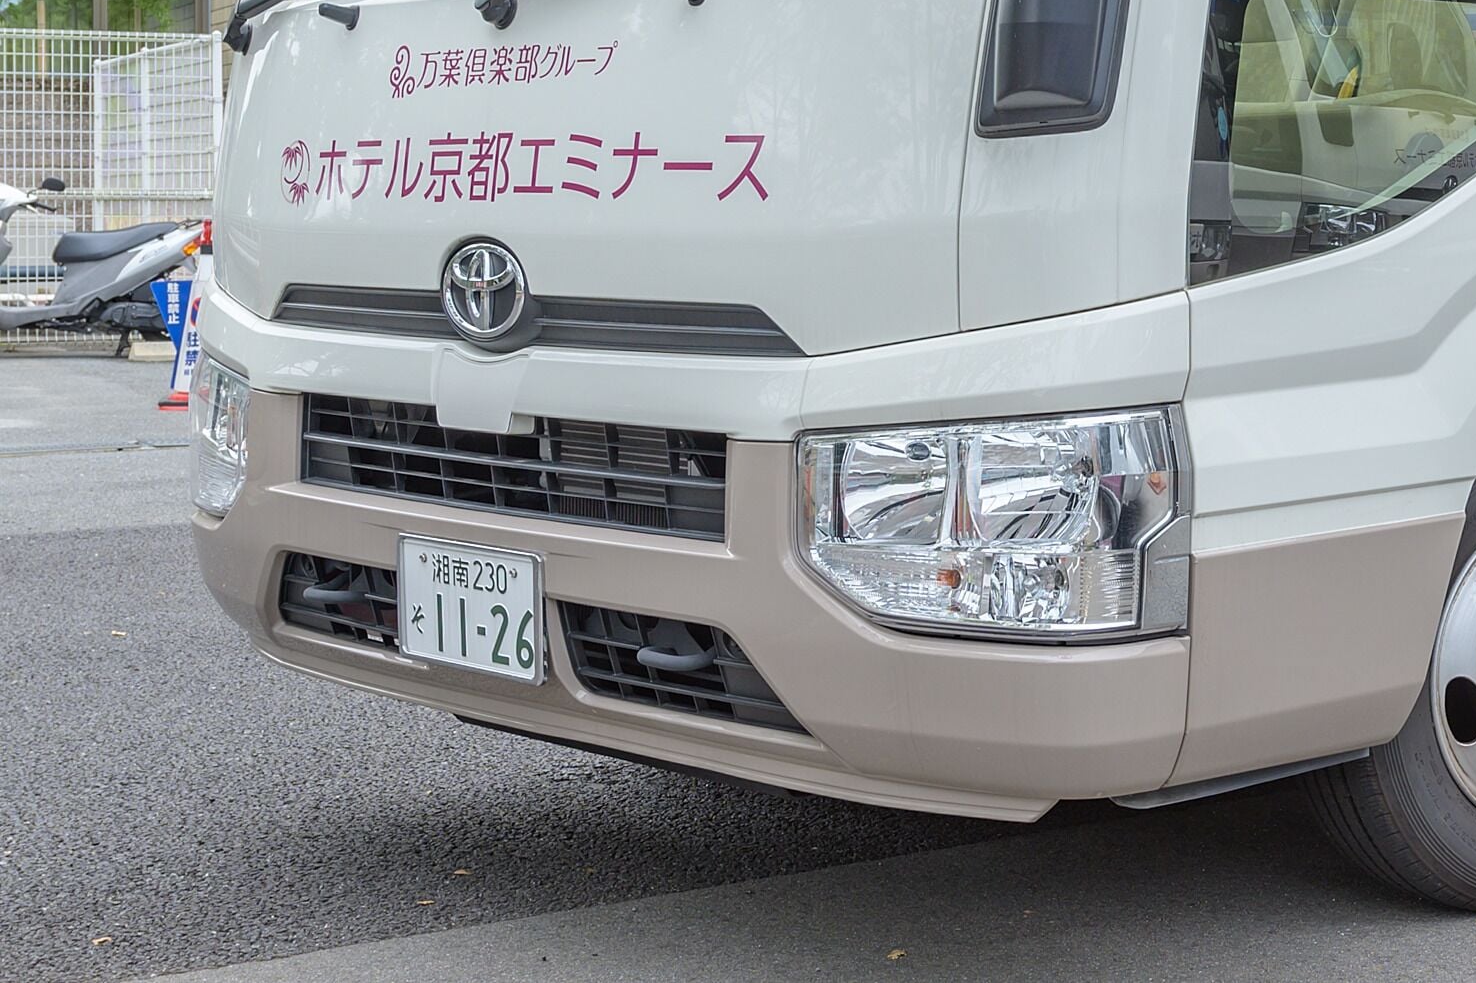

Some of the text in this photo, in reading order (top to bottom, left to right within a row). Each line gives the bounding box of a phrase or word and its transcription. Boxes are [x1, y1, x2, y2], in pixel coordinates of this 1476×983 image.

[314, 131, 769, 204] ホテル京都エミナース
[411, 593, 534, 669] そ 11-26
